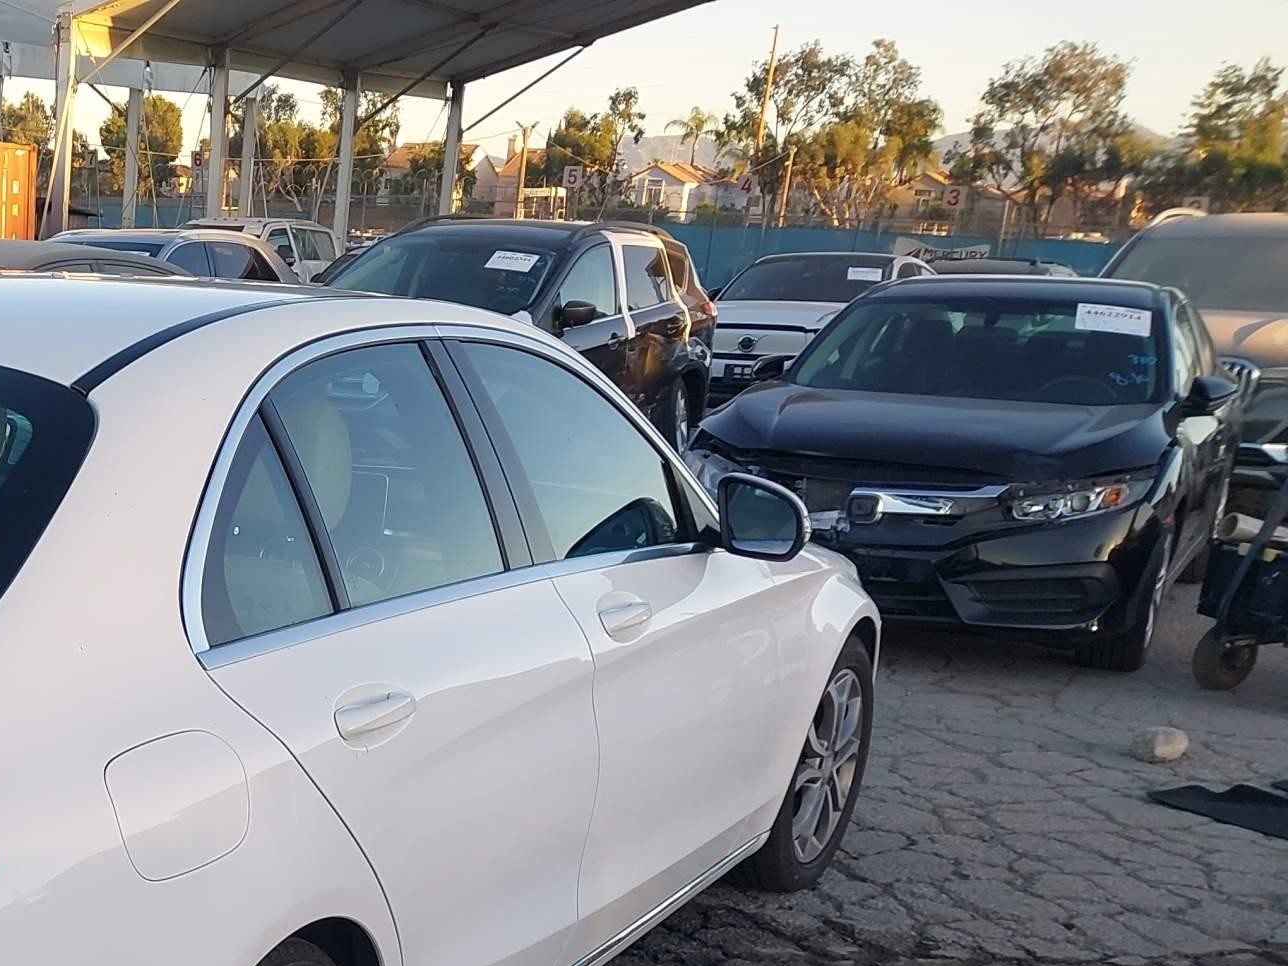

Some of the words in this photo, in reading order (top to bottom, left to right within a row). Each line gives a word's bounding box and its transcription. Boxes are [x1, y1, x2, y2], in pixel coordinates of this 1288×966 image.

[194, 152, 202, 166] 6
[567, 168, 577, 185] 5
[741, 178, 753, 194] 4
[946, 188, 961, 207] 3
[922, 247, 987, 260] MERCURY
